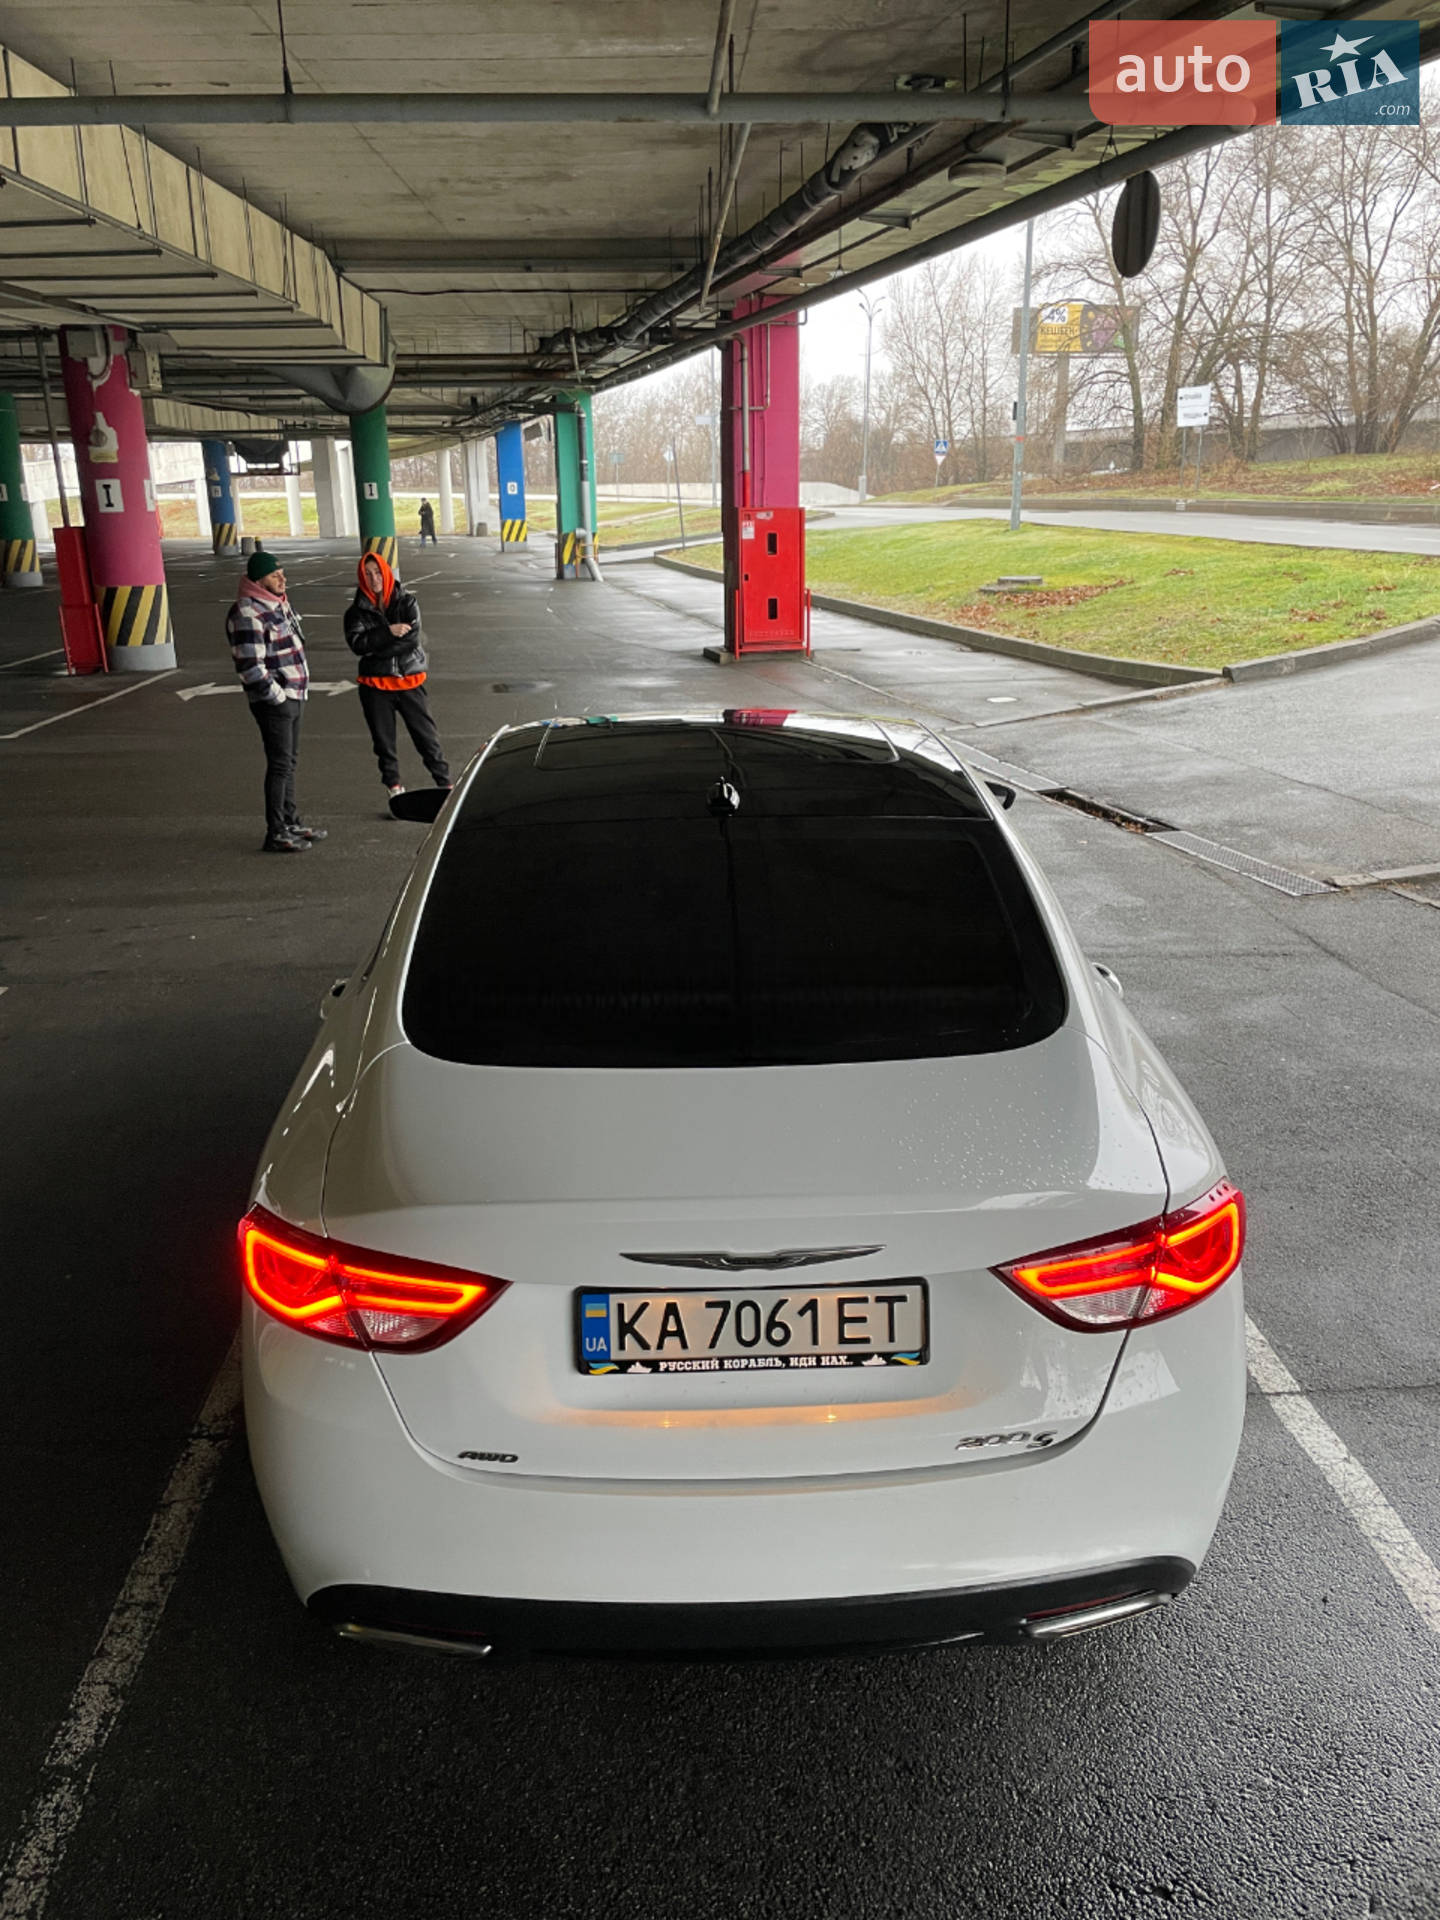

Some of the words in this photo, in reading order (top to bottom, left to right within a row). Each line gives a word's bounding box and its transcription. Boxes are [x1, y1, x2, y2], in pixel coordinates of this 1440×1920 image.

[704, 1298, 819, 1349] 7061
[837, 1295, 908, 1345] ET
[585, 1337, 608, 1352] UA
[659, 1358, 721, 1372] РУССКИЙ
[458, 1451, 519, 1463] AWD
